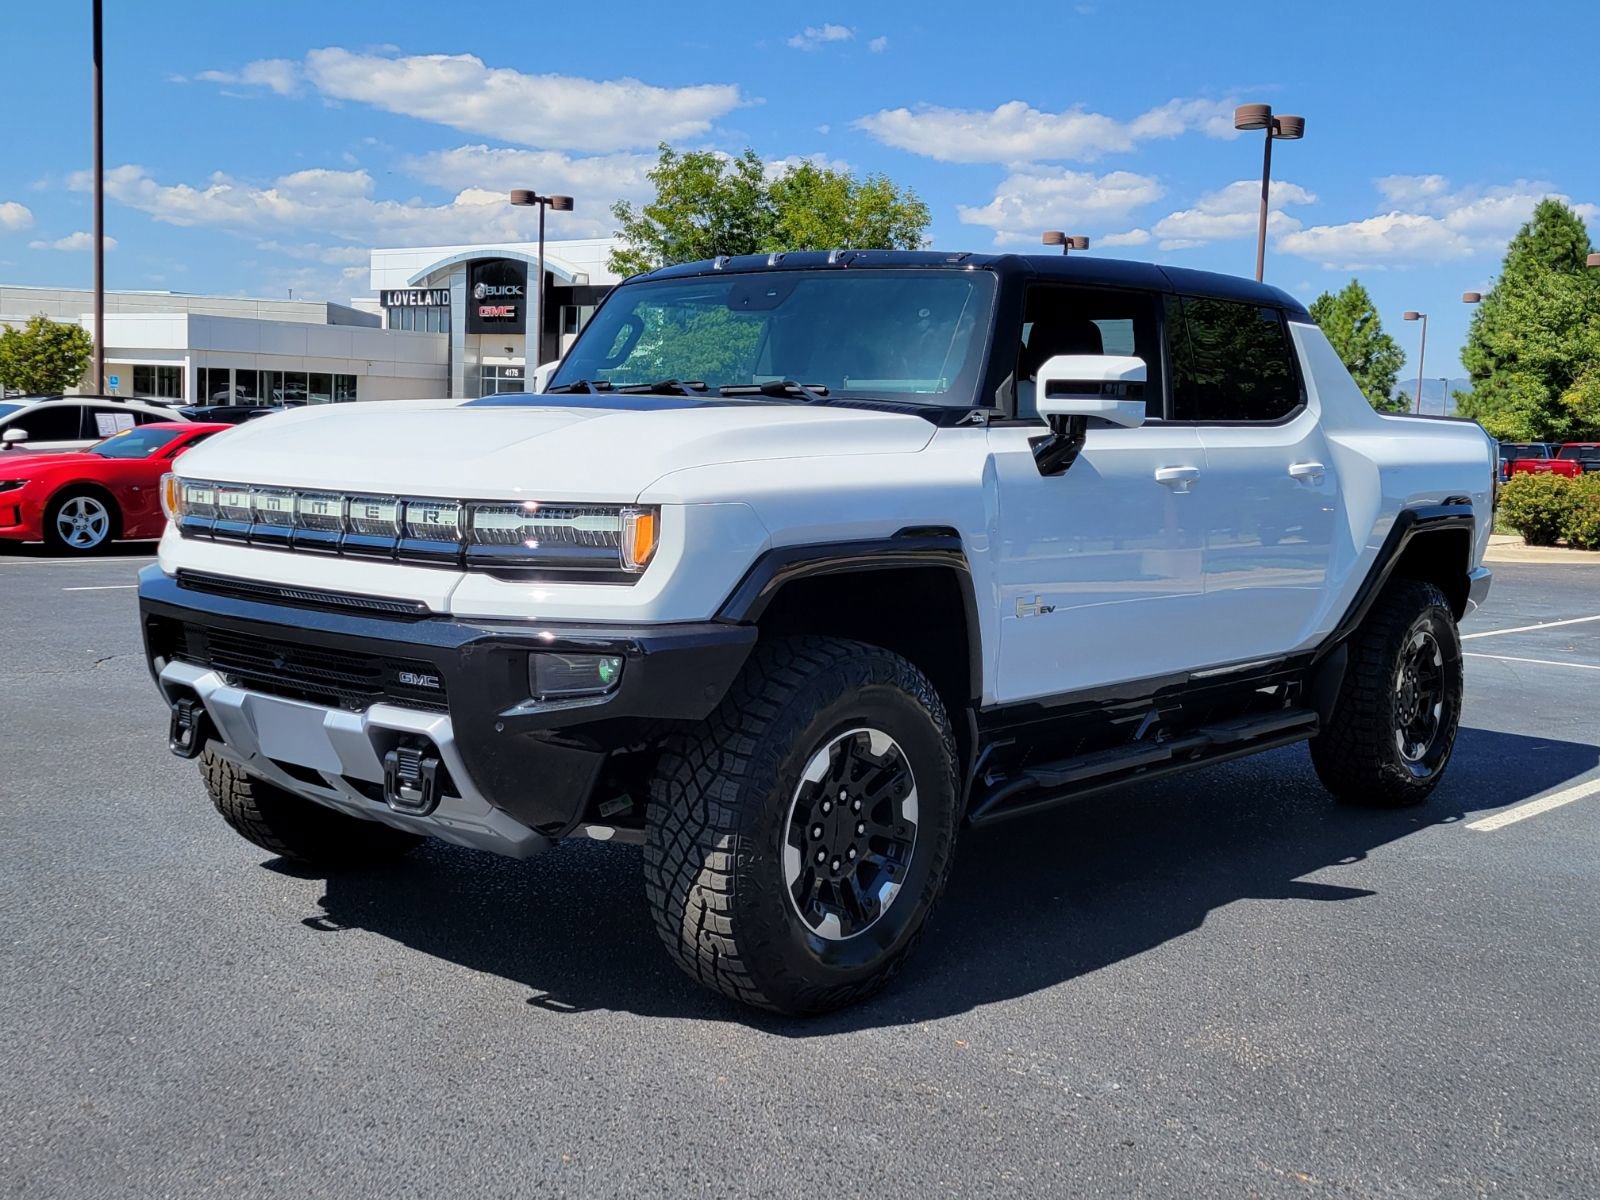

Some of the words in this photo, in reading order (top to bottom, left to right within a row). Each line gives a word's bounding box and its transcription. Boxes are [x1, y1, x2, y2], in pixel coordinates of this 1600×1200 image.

[485, 285, 524, 295] BUICK
[387, 290, 450, 306] LOVELAND
[479, 305, 515, 317] GMC
[505, 368, 519, 377] 4175
[399, 671, 440, 688] GMC
